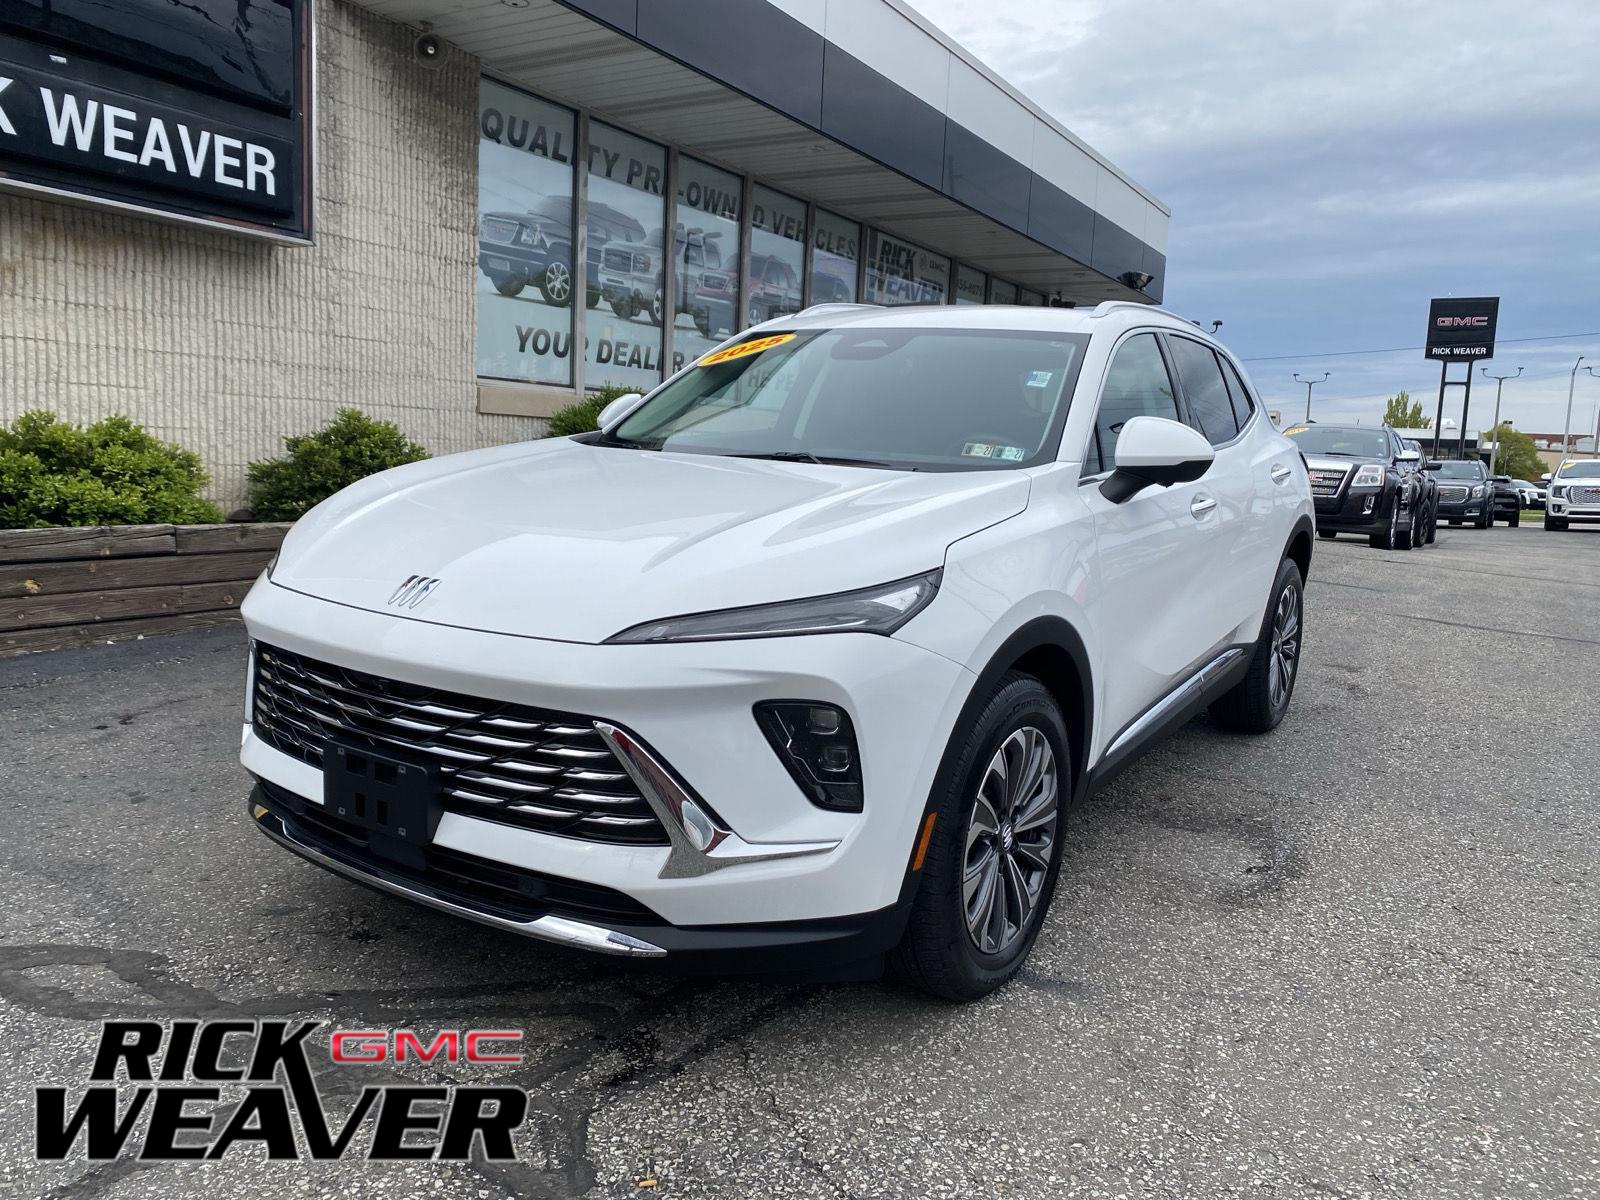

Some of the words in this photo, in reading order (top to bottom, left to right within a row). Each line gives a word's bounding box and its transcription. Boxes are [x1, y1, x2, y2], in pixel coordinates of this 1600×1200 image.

[40, 87, 276, 196] WEAVER
[481, 107, 620, 178] QUALTY
[626, 158, 765, 229] PR-OWND
[772, 210, 857, 260] VEHCLES
[1437, 316, 1488, 326] GMC
[1432, 347, 1451, 355] RICK
[1453, 347, 1486, 355] WEAVER
